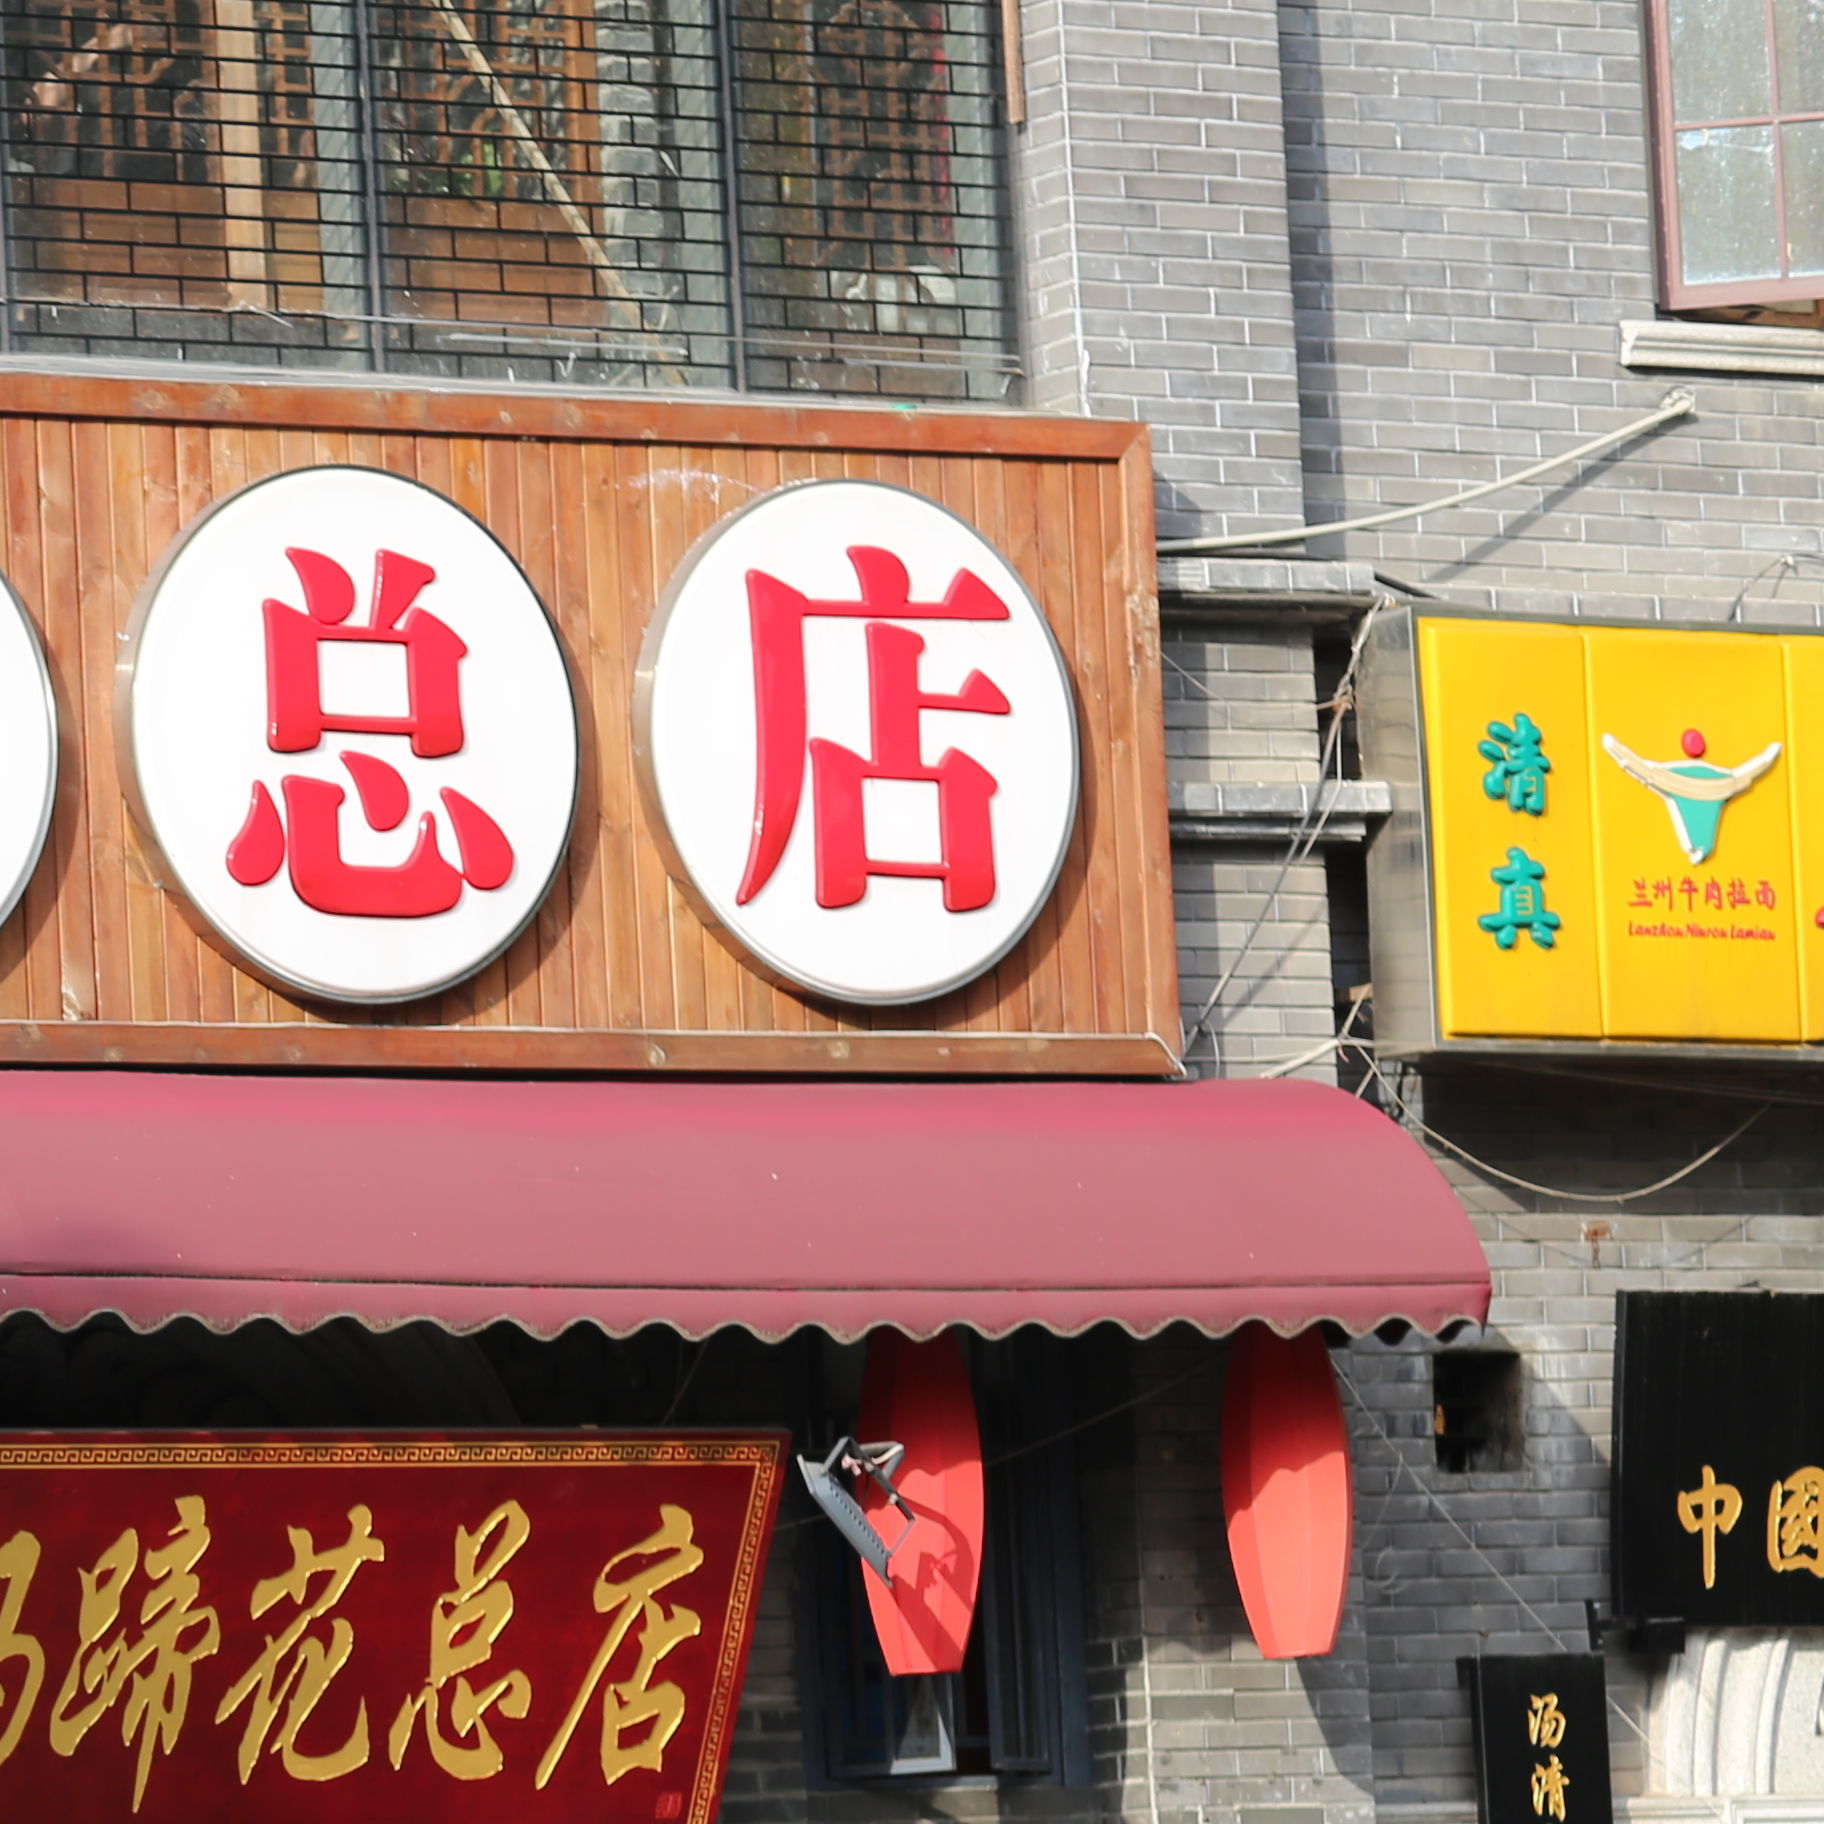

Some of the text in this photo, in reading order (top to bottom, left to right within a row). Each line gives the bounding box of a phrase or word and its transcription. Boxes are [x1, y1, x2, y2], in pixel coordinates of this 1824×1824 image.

[1477, 712, 1561, 950] 清真
[1627, 875, 1776, 912] 兰州牛肉拉面
[1627, 920, 1685, 938] Lanzhou
[1730, 924, 1776, 941] Lamian
